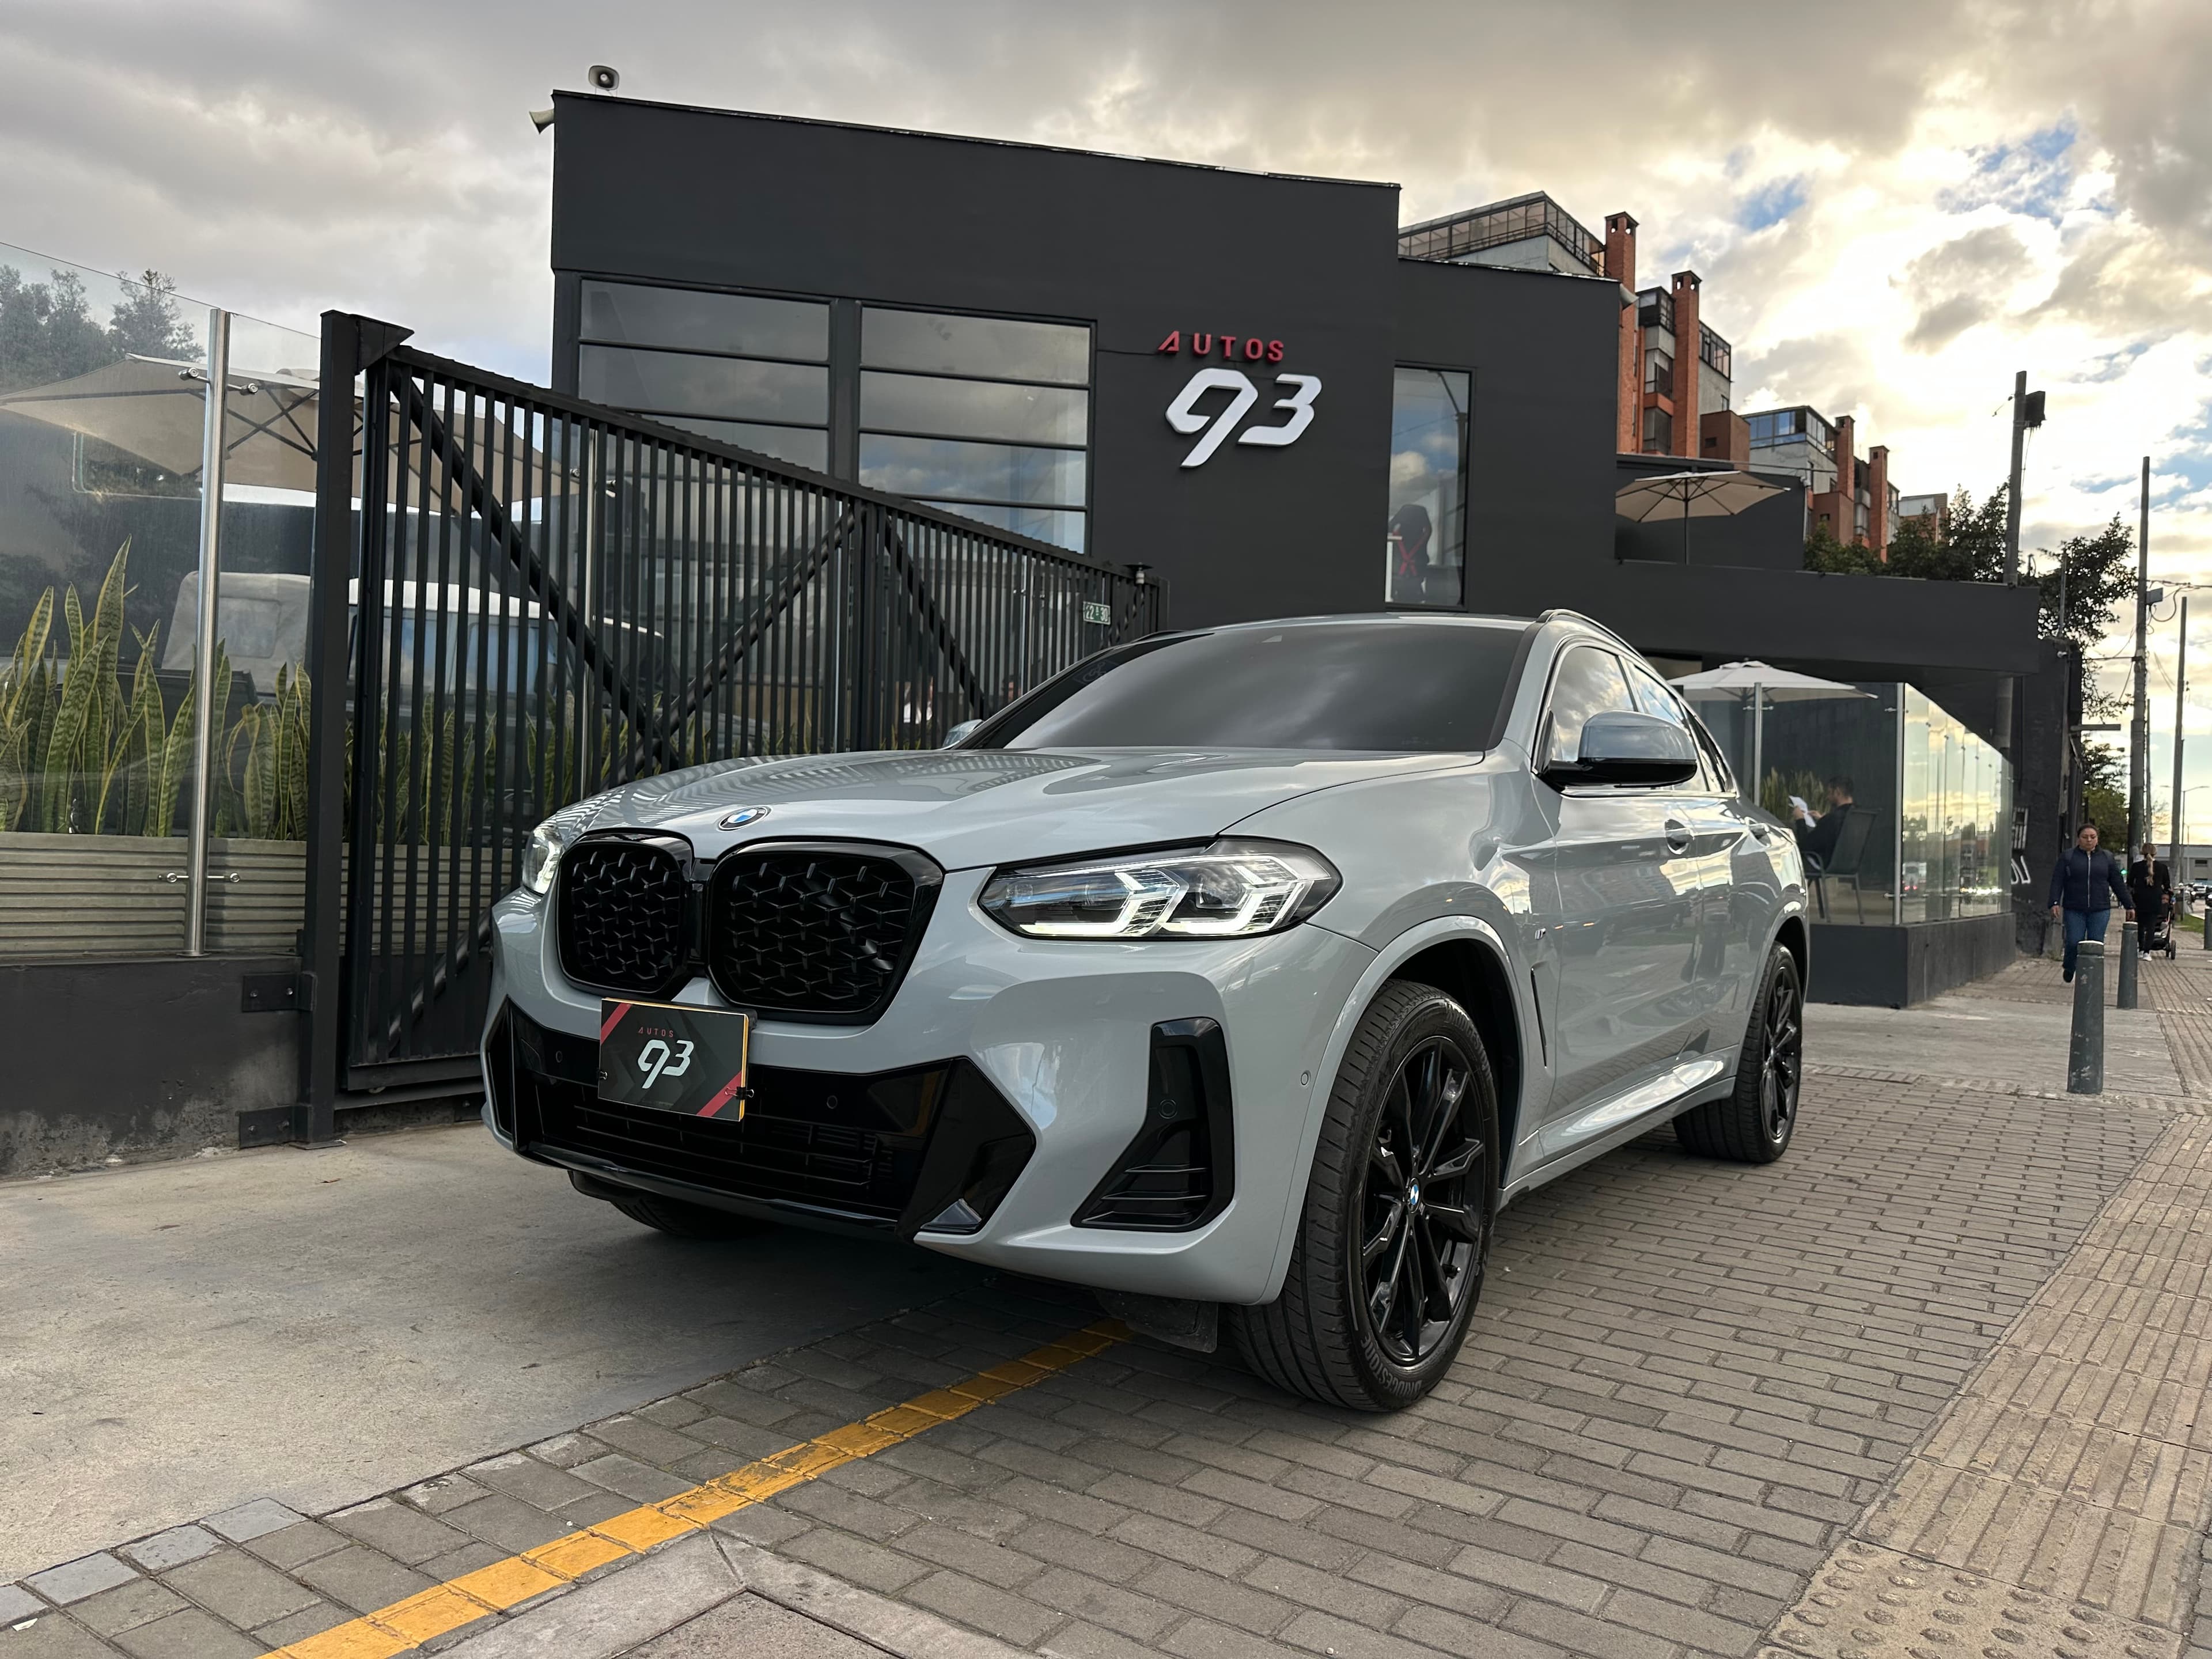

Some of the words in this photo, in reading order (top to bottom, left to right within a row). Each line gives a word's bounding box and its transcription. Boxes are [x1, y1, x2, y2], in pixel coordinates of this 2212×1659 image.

[1158, 330, 1284, 362] AUTOS
[1165, 368, 1323, 468] 93
[638, 1026, 674, 1037] AUTOS
[637, 1039, 695, 1089] 93
